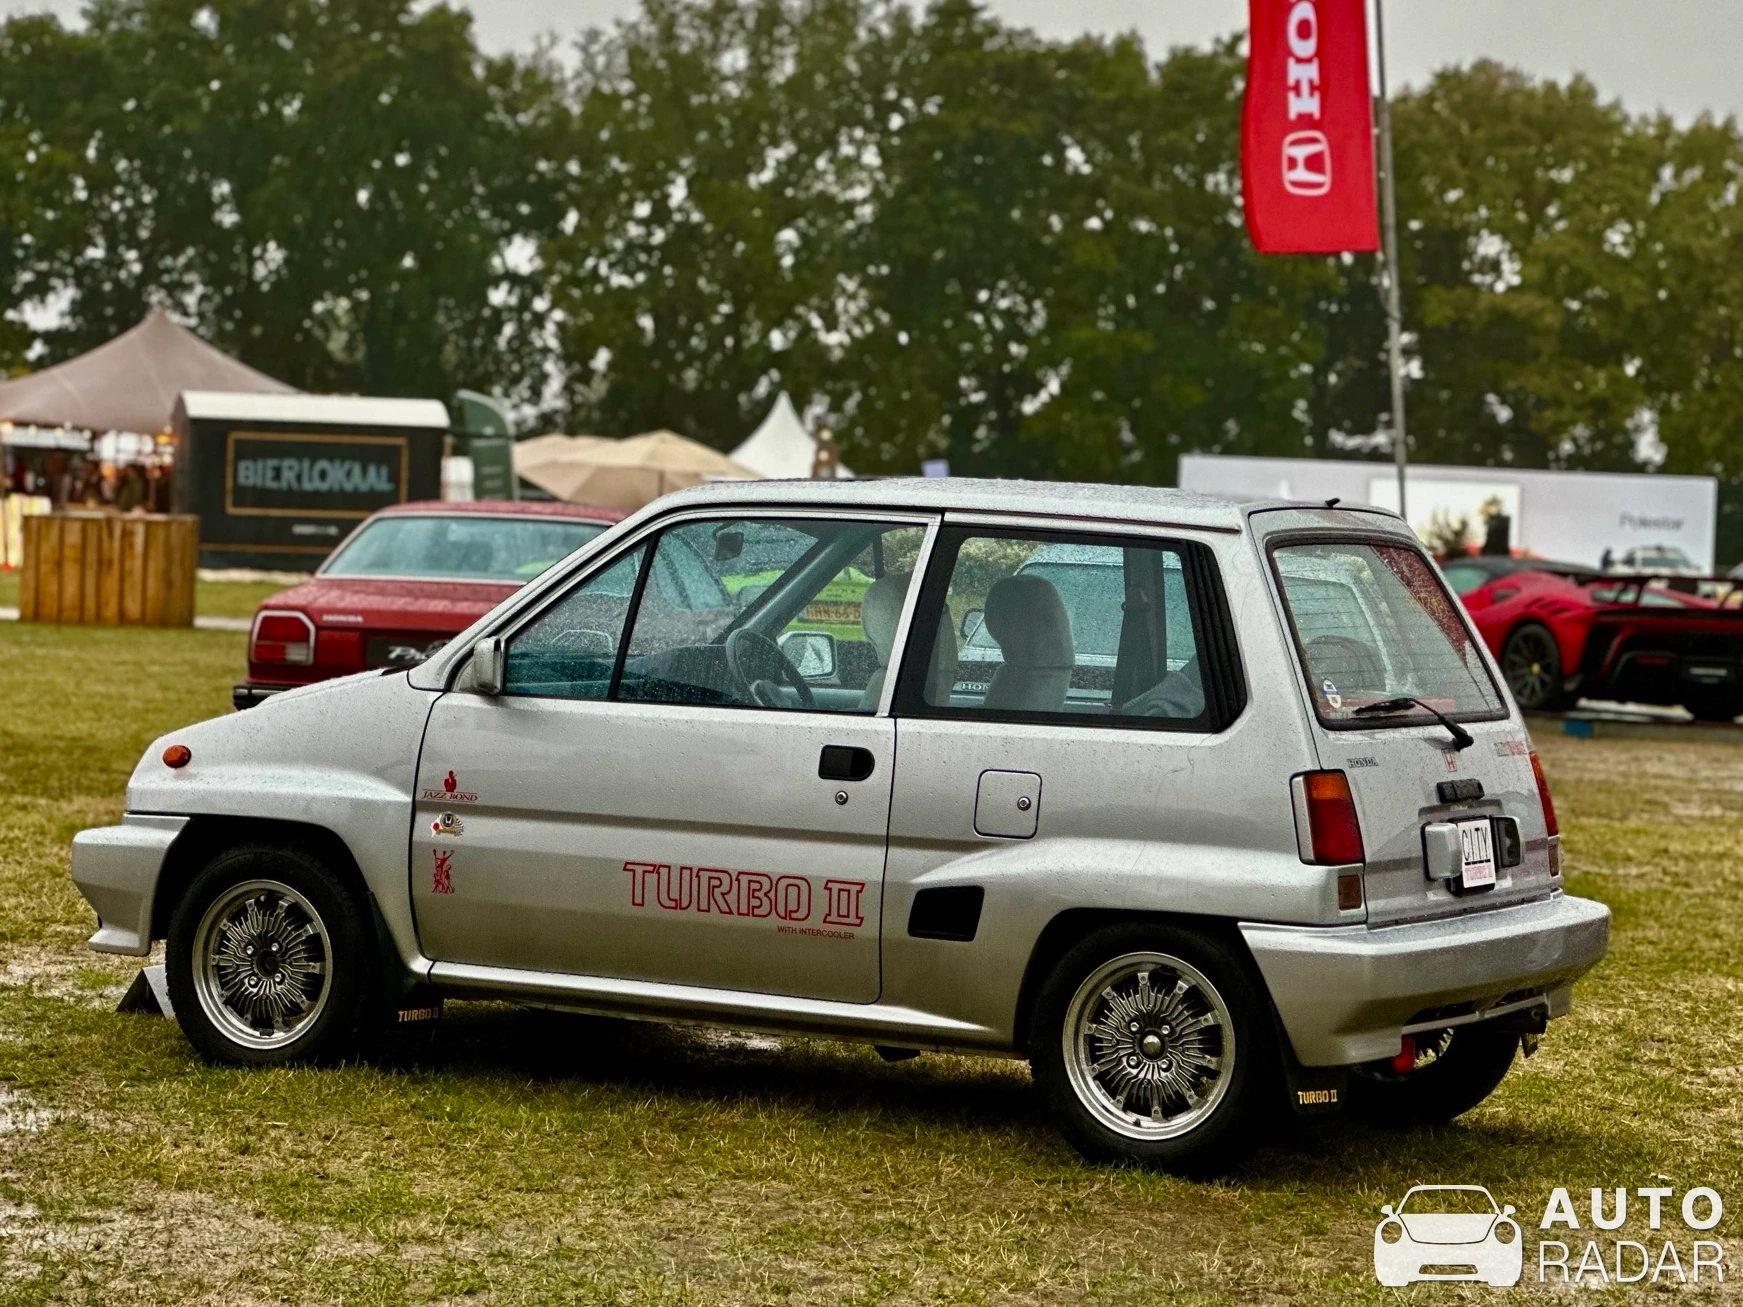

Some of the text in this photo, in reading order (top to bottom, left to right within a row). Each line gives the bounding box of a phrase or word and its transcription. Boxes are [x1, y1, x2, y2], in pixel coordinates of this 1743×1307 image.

[1286, 0, 1321, 121] HO
[1346, 757, 1379, 768] HONDA
[422, 791, 478, 802] JAZZ BOND
[622, 861, 866, 927] TURBO II
[777, 925, 855, 940] WITH INTERCOOLER
[398, 1009, 431, 1022] TURBO
[1297, 1090, 1338, 1105] TURBO II
